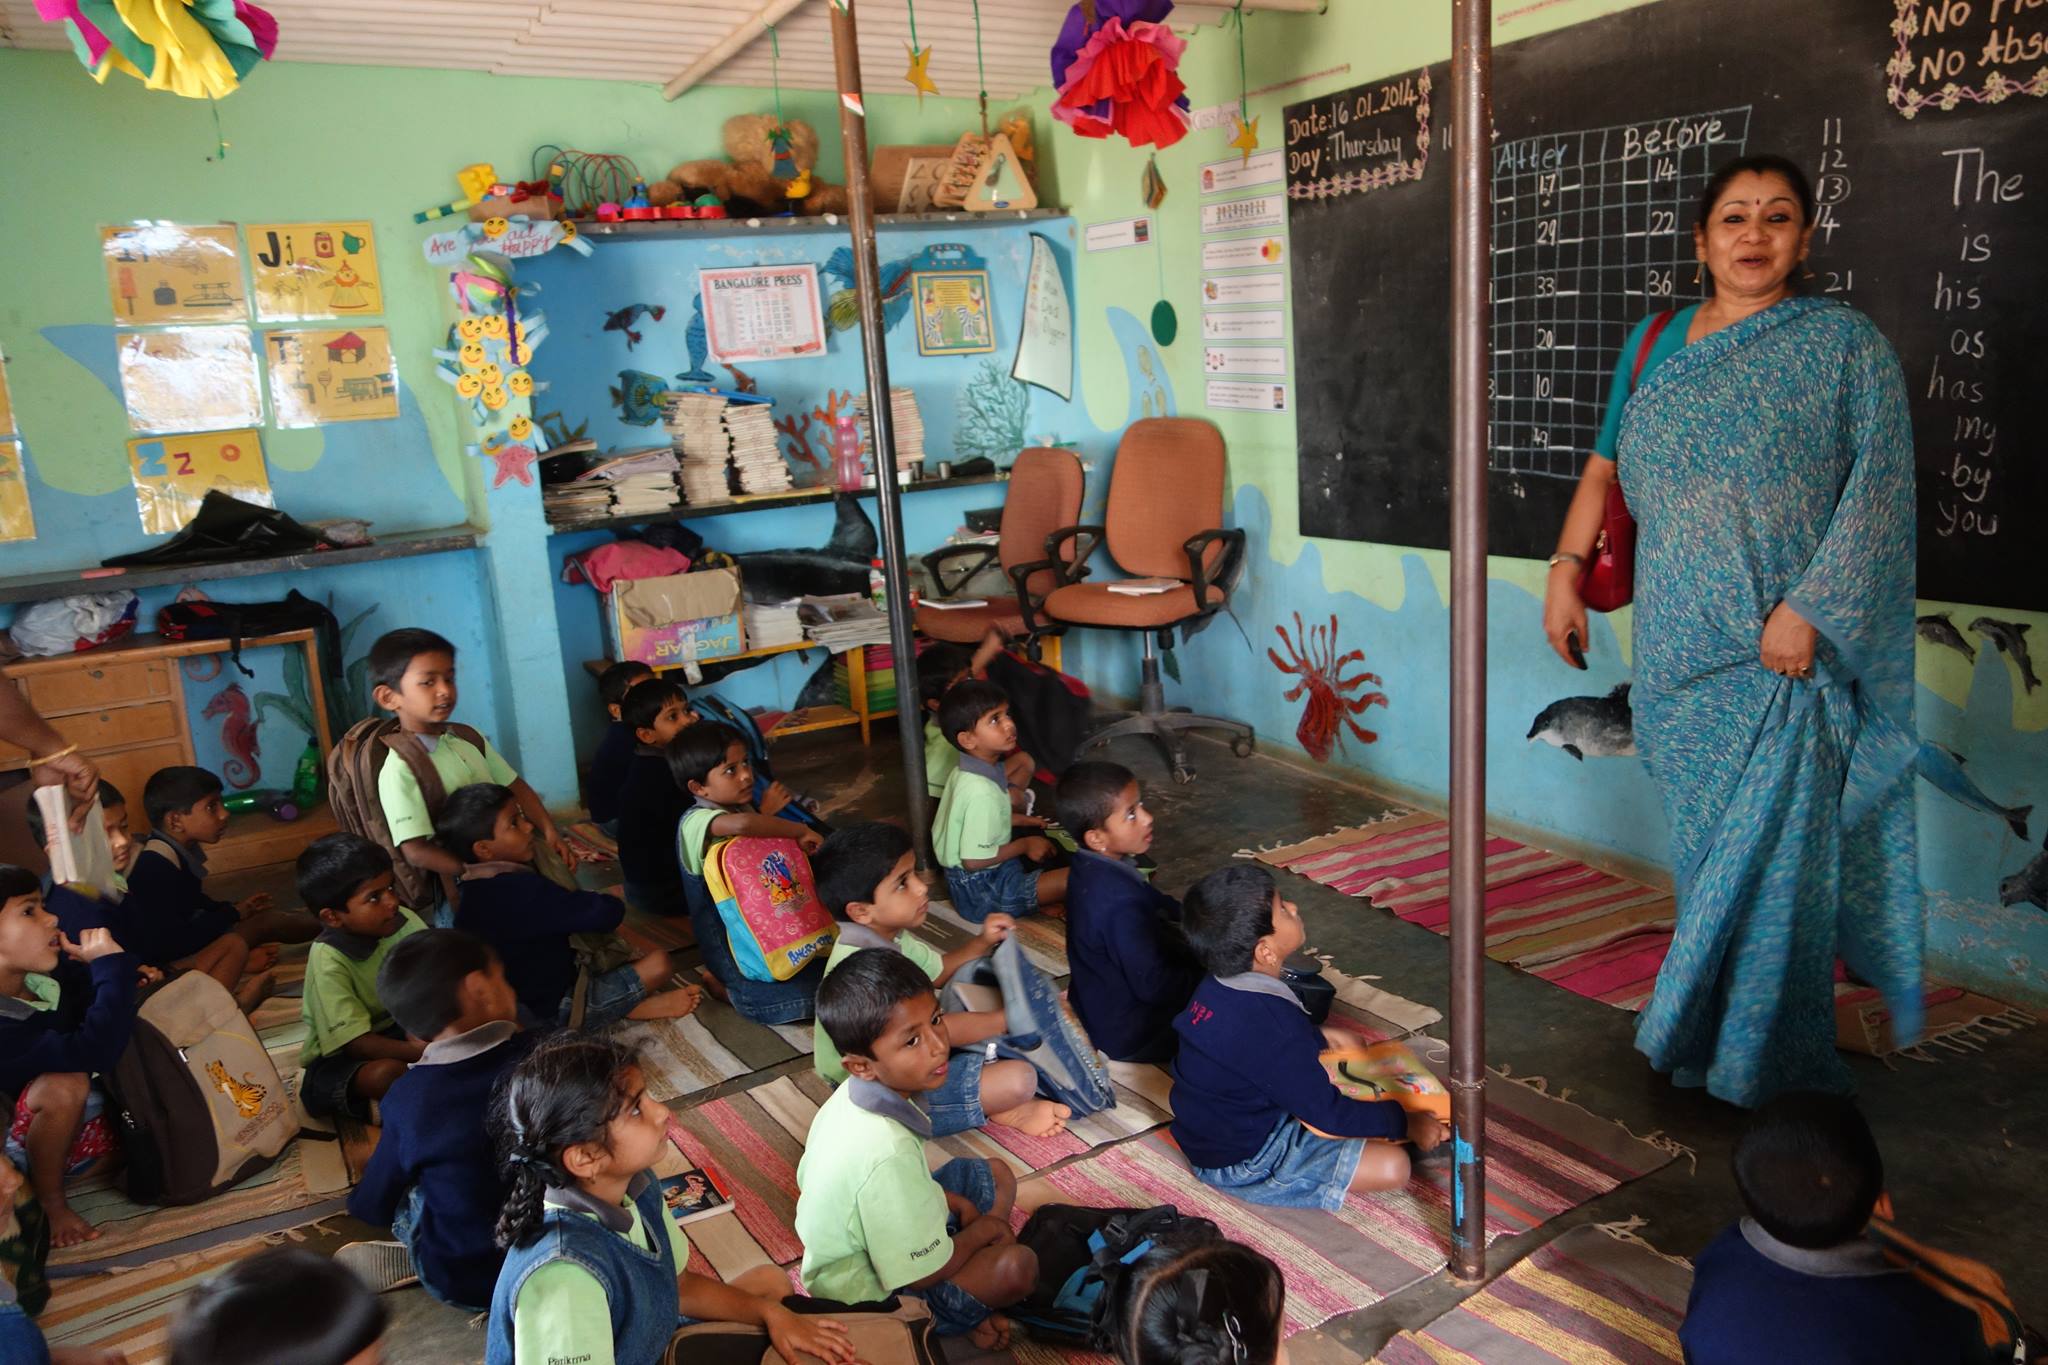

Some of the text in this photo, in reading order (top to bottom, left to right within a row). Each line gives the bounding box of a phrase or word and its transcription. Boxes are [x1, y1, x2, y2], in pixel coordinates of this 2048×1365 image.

[1977, 26, 2048, 67] Abs
[1328, 128, 1401, 166] Thursday
[1497, 117, 1726, 173] After Before
[1823, 118, 1841, 146] 11
[1654, 157, 1677, 182] 14
[1819, 149, 1848, 173] 12
[1942, 147, 2024, 206] The
[1815, 177, 1843, 202] 13
[1536, 211, 1676, 246] 29 22
[1813, 205, 1841, 244] 14
[1960, 224, 1992, 262] is
[713, 274, 803, 290] BANGALORE PRESS
[1536, 270, 1852, 297] 33 36 21
[1934, 271, 1982, 311] his
[1536, 328, 1554, 350] 20
[1950, 328, 1985, 359] as
[1535, 373, 1550, 400] 10
[1927, 354, 1985, 403] has
[1954, 415, 1998, 456] my
[1951, 452, 1992, 502] by
[655, 636, 736, 658] JAGAR
